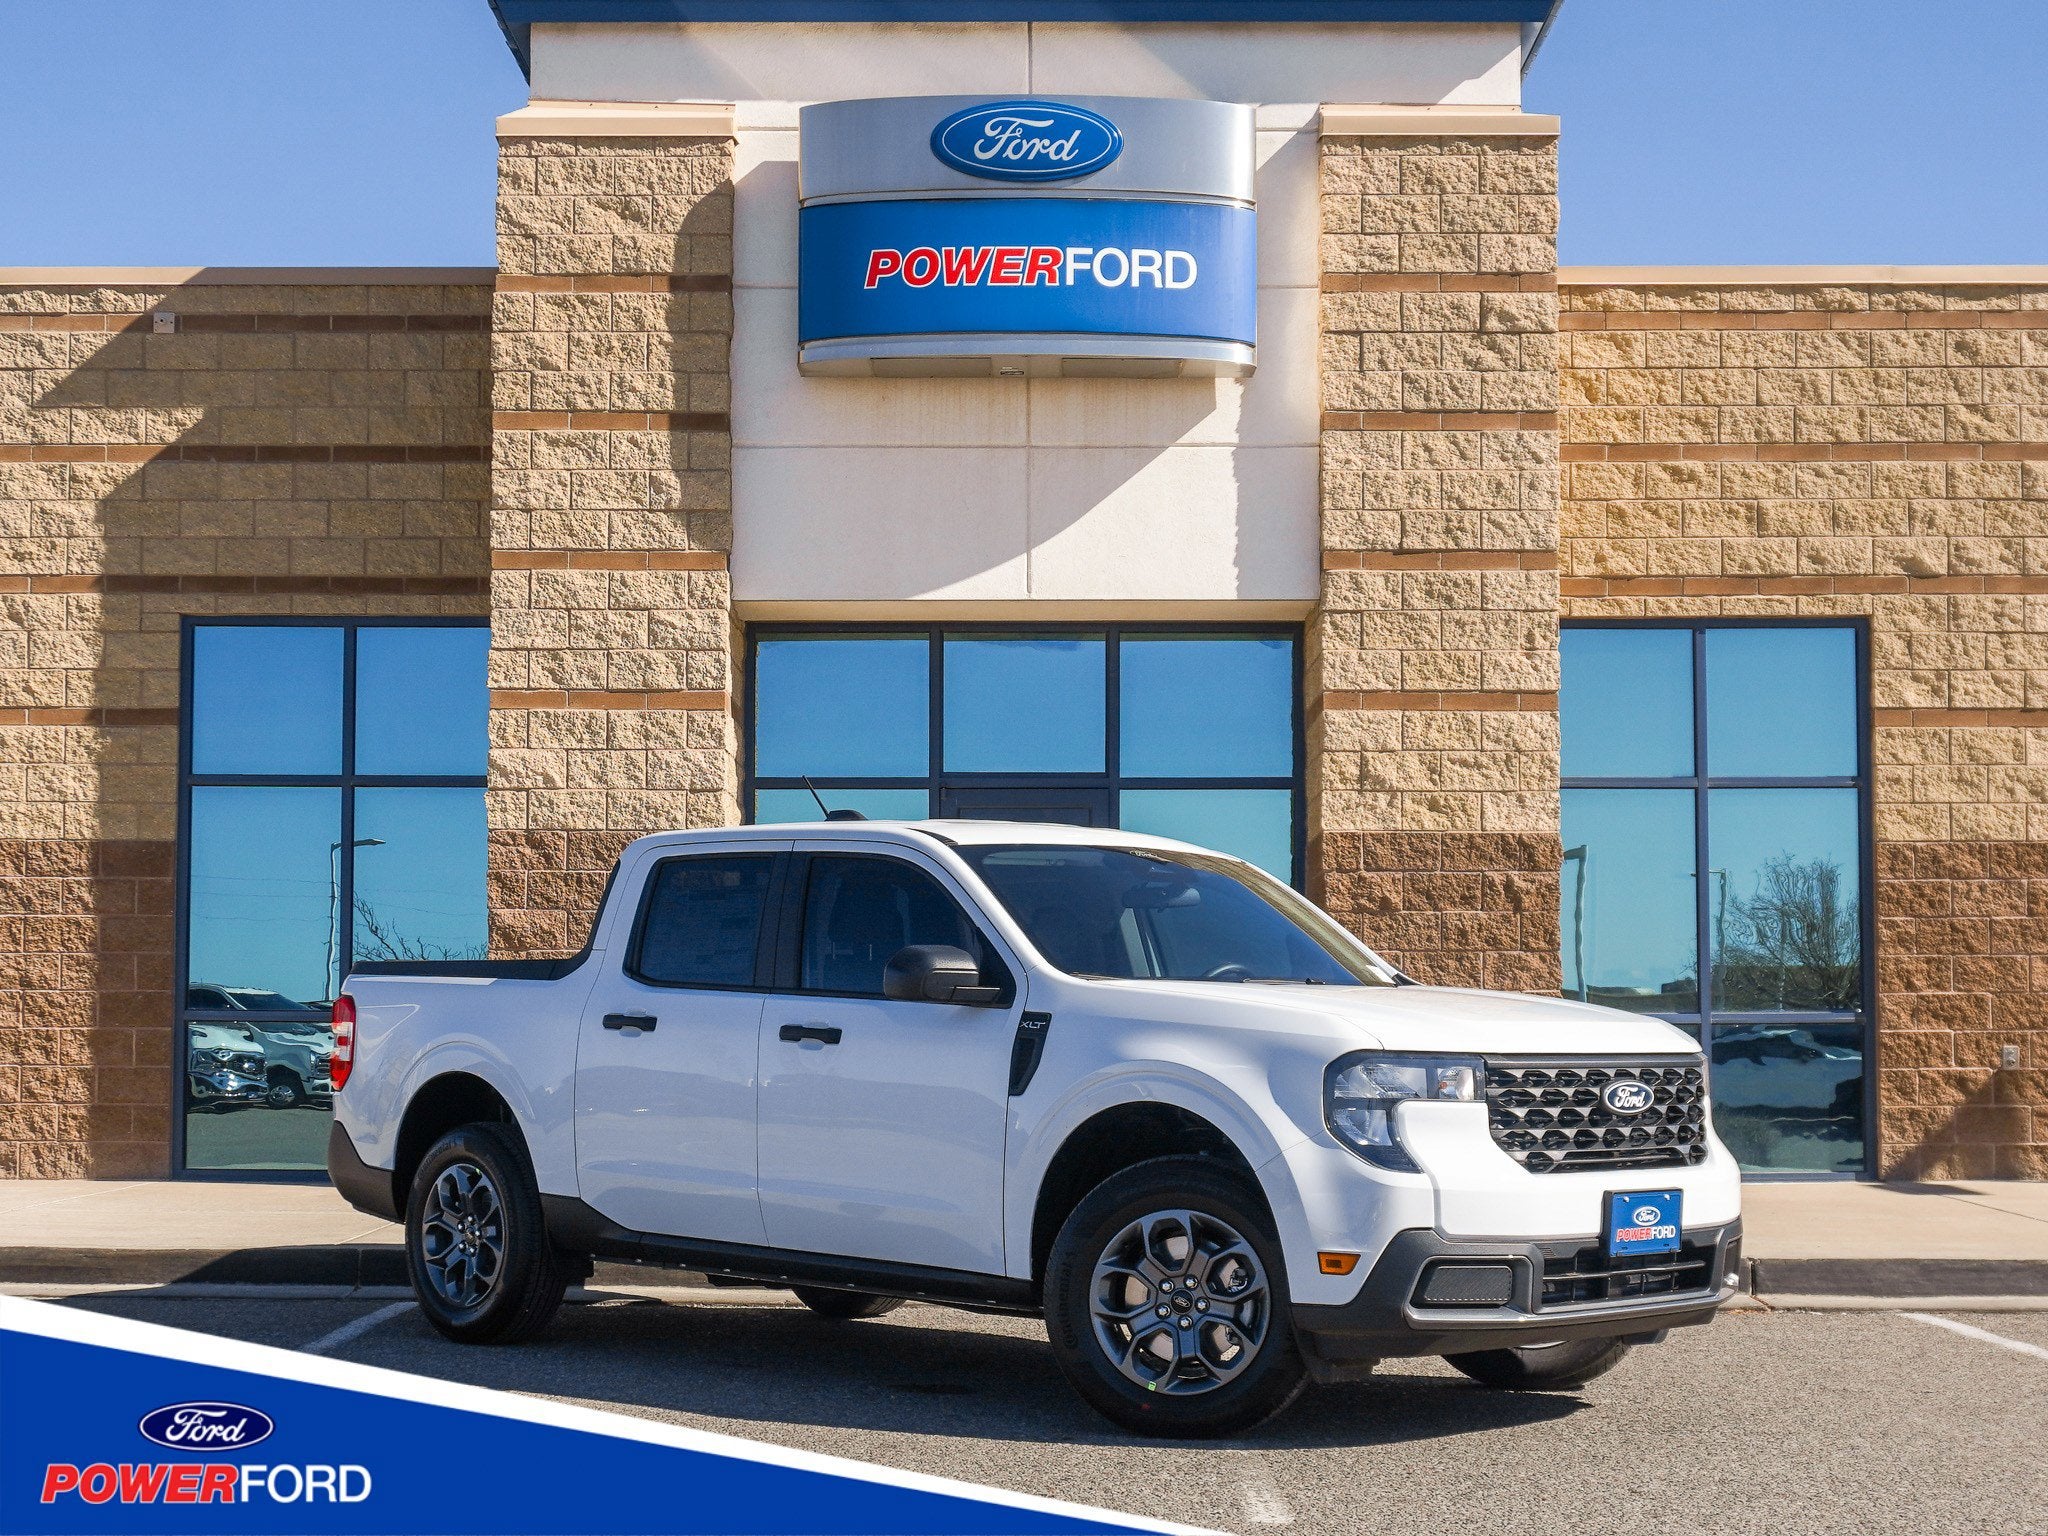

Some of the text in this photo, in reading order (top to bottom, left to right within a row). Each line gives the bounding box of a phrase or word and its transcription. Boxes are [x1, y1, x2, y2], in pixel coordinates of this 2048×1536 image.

[974, 116, 1082, 162] Ford
[1020, 1021, 1046, 1029] XLT
[1614, 1085, 1646, 1108] Ford
